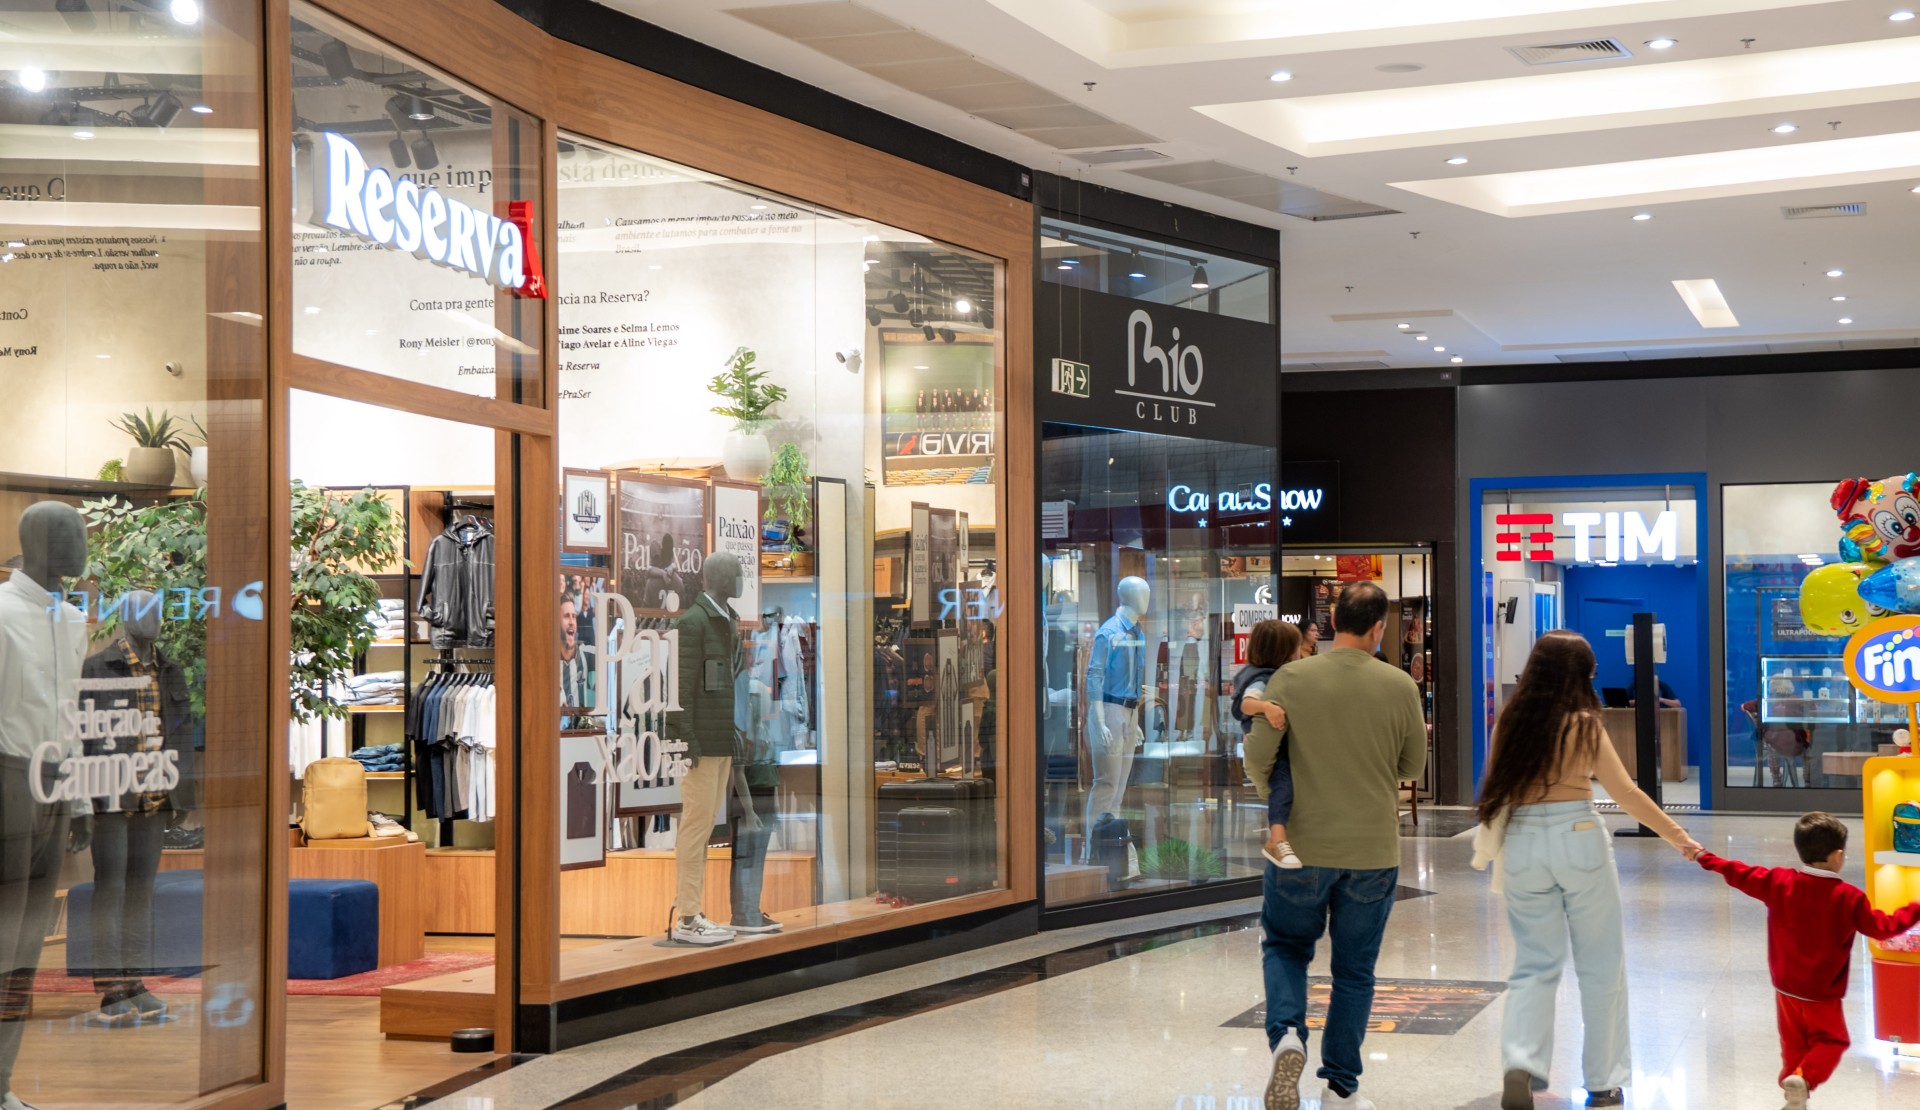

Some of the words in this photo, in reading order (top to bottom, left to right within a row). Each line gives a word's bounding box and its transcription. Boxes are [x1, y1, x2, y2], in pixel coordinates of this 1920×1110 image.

[446, 165, 492, 193] imp
[326, 132, 525, 288] Reserva
[777, 211, 798, 220] meio
[409, 299, 442, 311] Conta
[445, 302, 463, 312] pra
[465, 299, 494, 312] gente
[558, 293, 580, 305] ncia
[583, 297, 596, 305] na
[600, 290, 650, 304] Reserva?
[400, 339, 423, 351] Rony
[425, 337, 460, 348] Meisler
[558, 325, 580, 335] aime
[582, 325, 612, 335] Soares
[613, 326, 619, 334] e
[620, 324, 648, 333] Selma
[650, 323, 680, 333] Lemos
[583, 339, 612, 349] Avelar
[620, 338, 646, 348] Aline
[647, 337, 678, 348] Viegas
[1128, 309, 1203, 396] Rio
[458, 365, 497, 376] Embaixa
[565, 361, 600, 371] Reserva
[1136, 401, 1197, 425] CLUB
[719, 516, 755, 540] Paixão
[1562, 510, 1677, 563] TIM
[623, 532, 652, 571] Pai
[672, 539, 702, 574] xão
[587, 592, 684, 716] Pai
[60, 698, 142, 750] Seleção
[589, 717, 661, 785] xão
